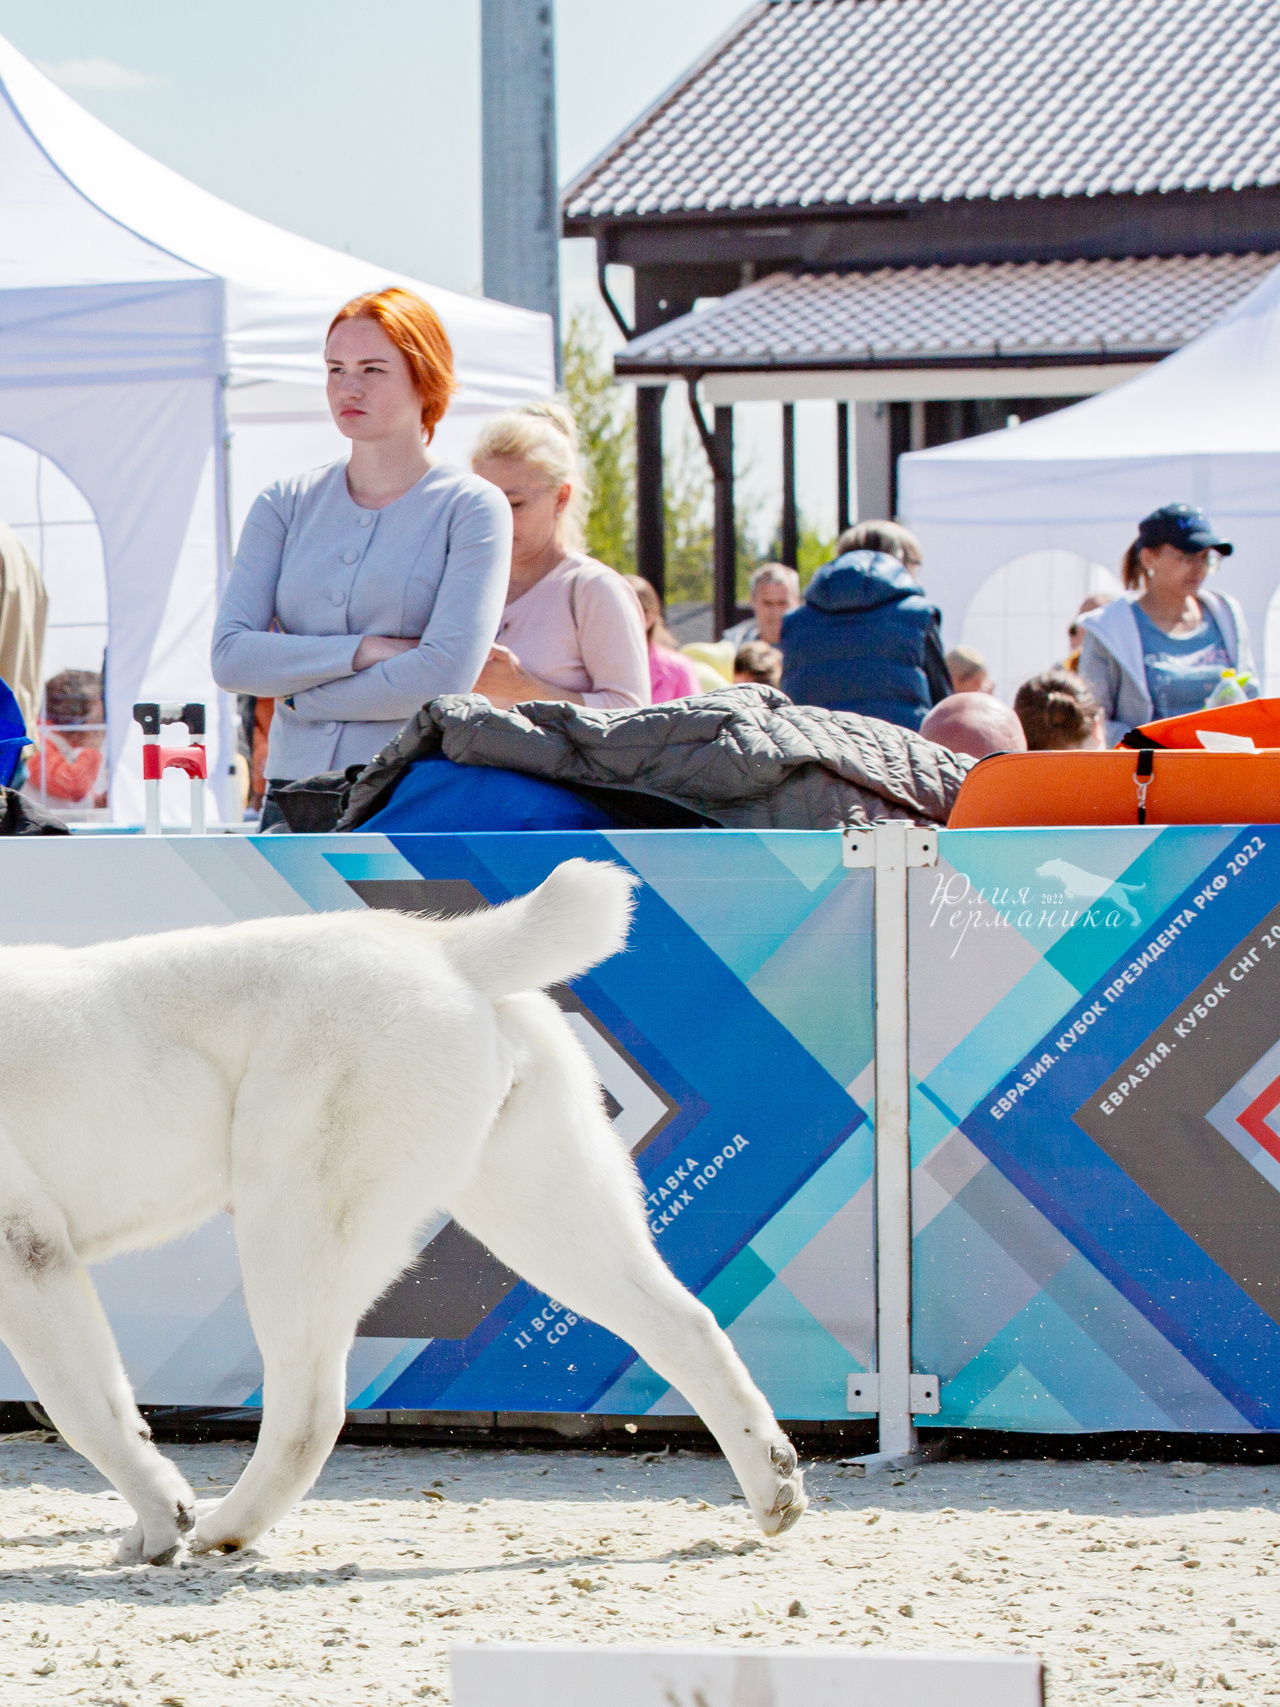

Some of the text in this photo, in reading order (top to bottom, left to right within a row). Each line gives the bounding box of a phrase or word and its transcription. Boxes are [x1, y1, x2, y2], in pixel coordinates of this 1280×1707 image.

[989, 835, 1267, 1121] ЕВРАЗИЯ. КУБОК ПРЕЗИДЕНТА РКФ 2022
[1099, 1042, 1176, 1116] ЕВРАЗИЯ.
[1173, 982, 1230, 1039] КУБОК
[1228, 947, 1262, 983] СНГ
[546, 1134, 750, 1344] СОБ СКИХ ПОРОД
[514, 1331, 533, 1349] II
